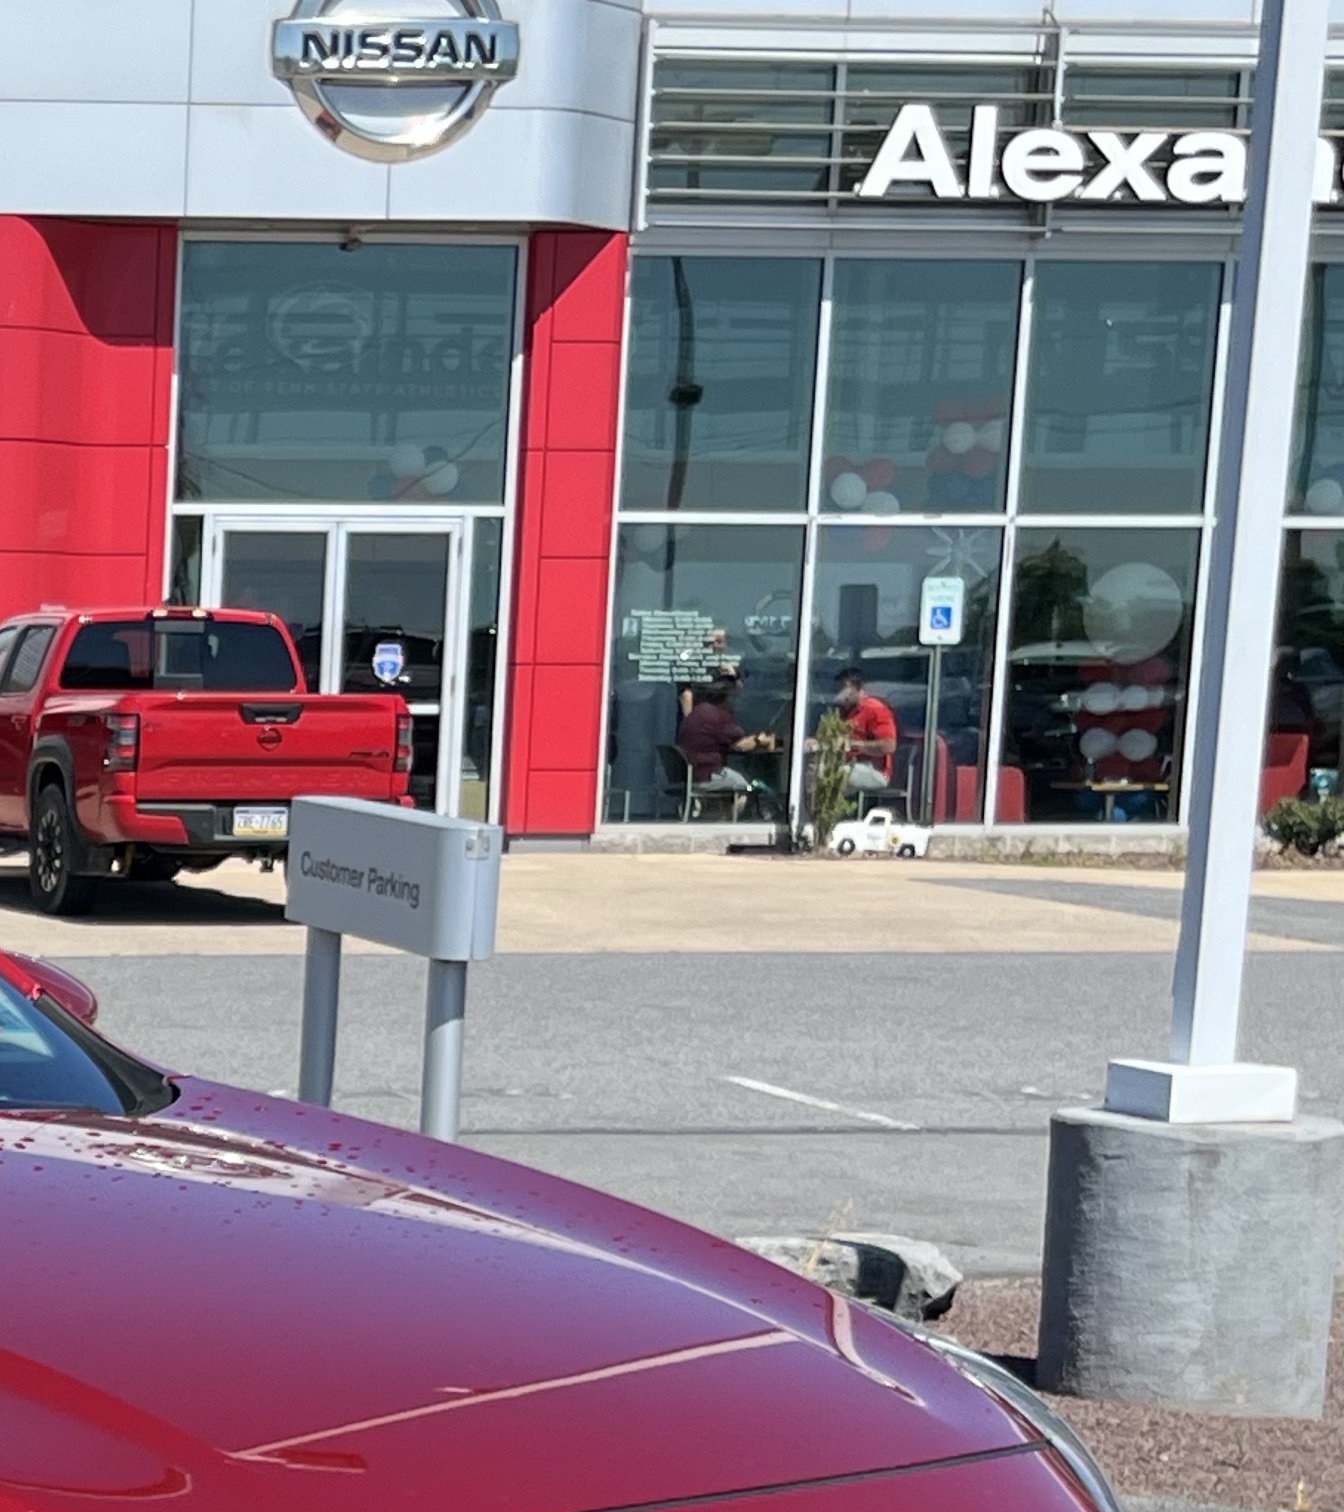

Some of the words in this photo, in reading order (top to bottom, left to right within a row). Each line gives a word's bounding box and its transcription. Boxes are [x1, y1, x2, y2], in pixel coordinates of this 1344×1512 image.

[299, 28, 499, 68] NISSAN
[857, 104, 1344, 203] Alexa
[300, 850, 365, 889] Customer
[367, 867, 420, 909] Parking
